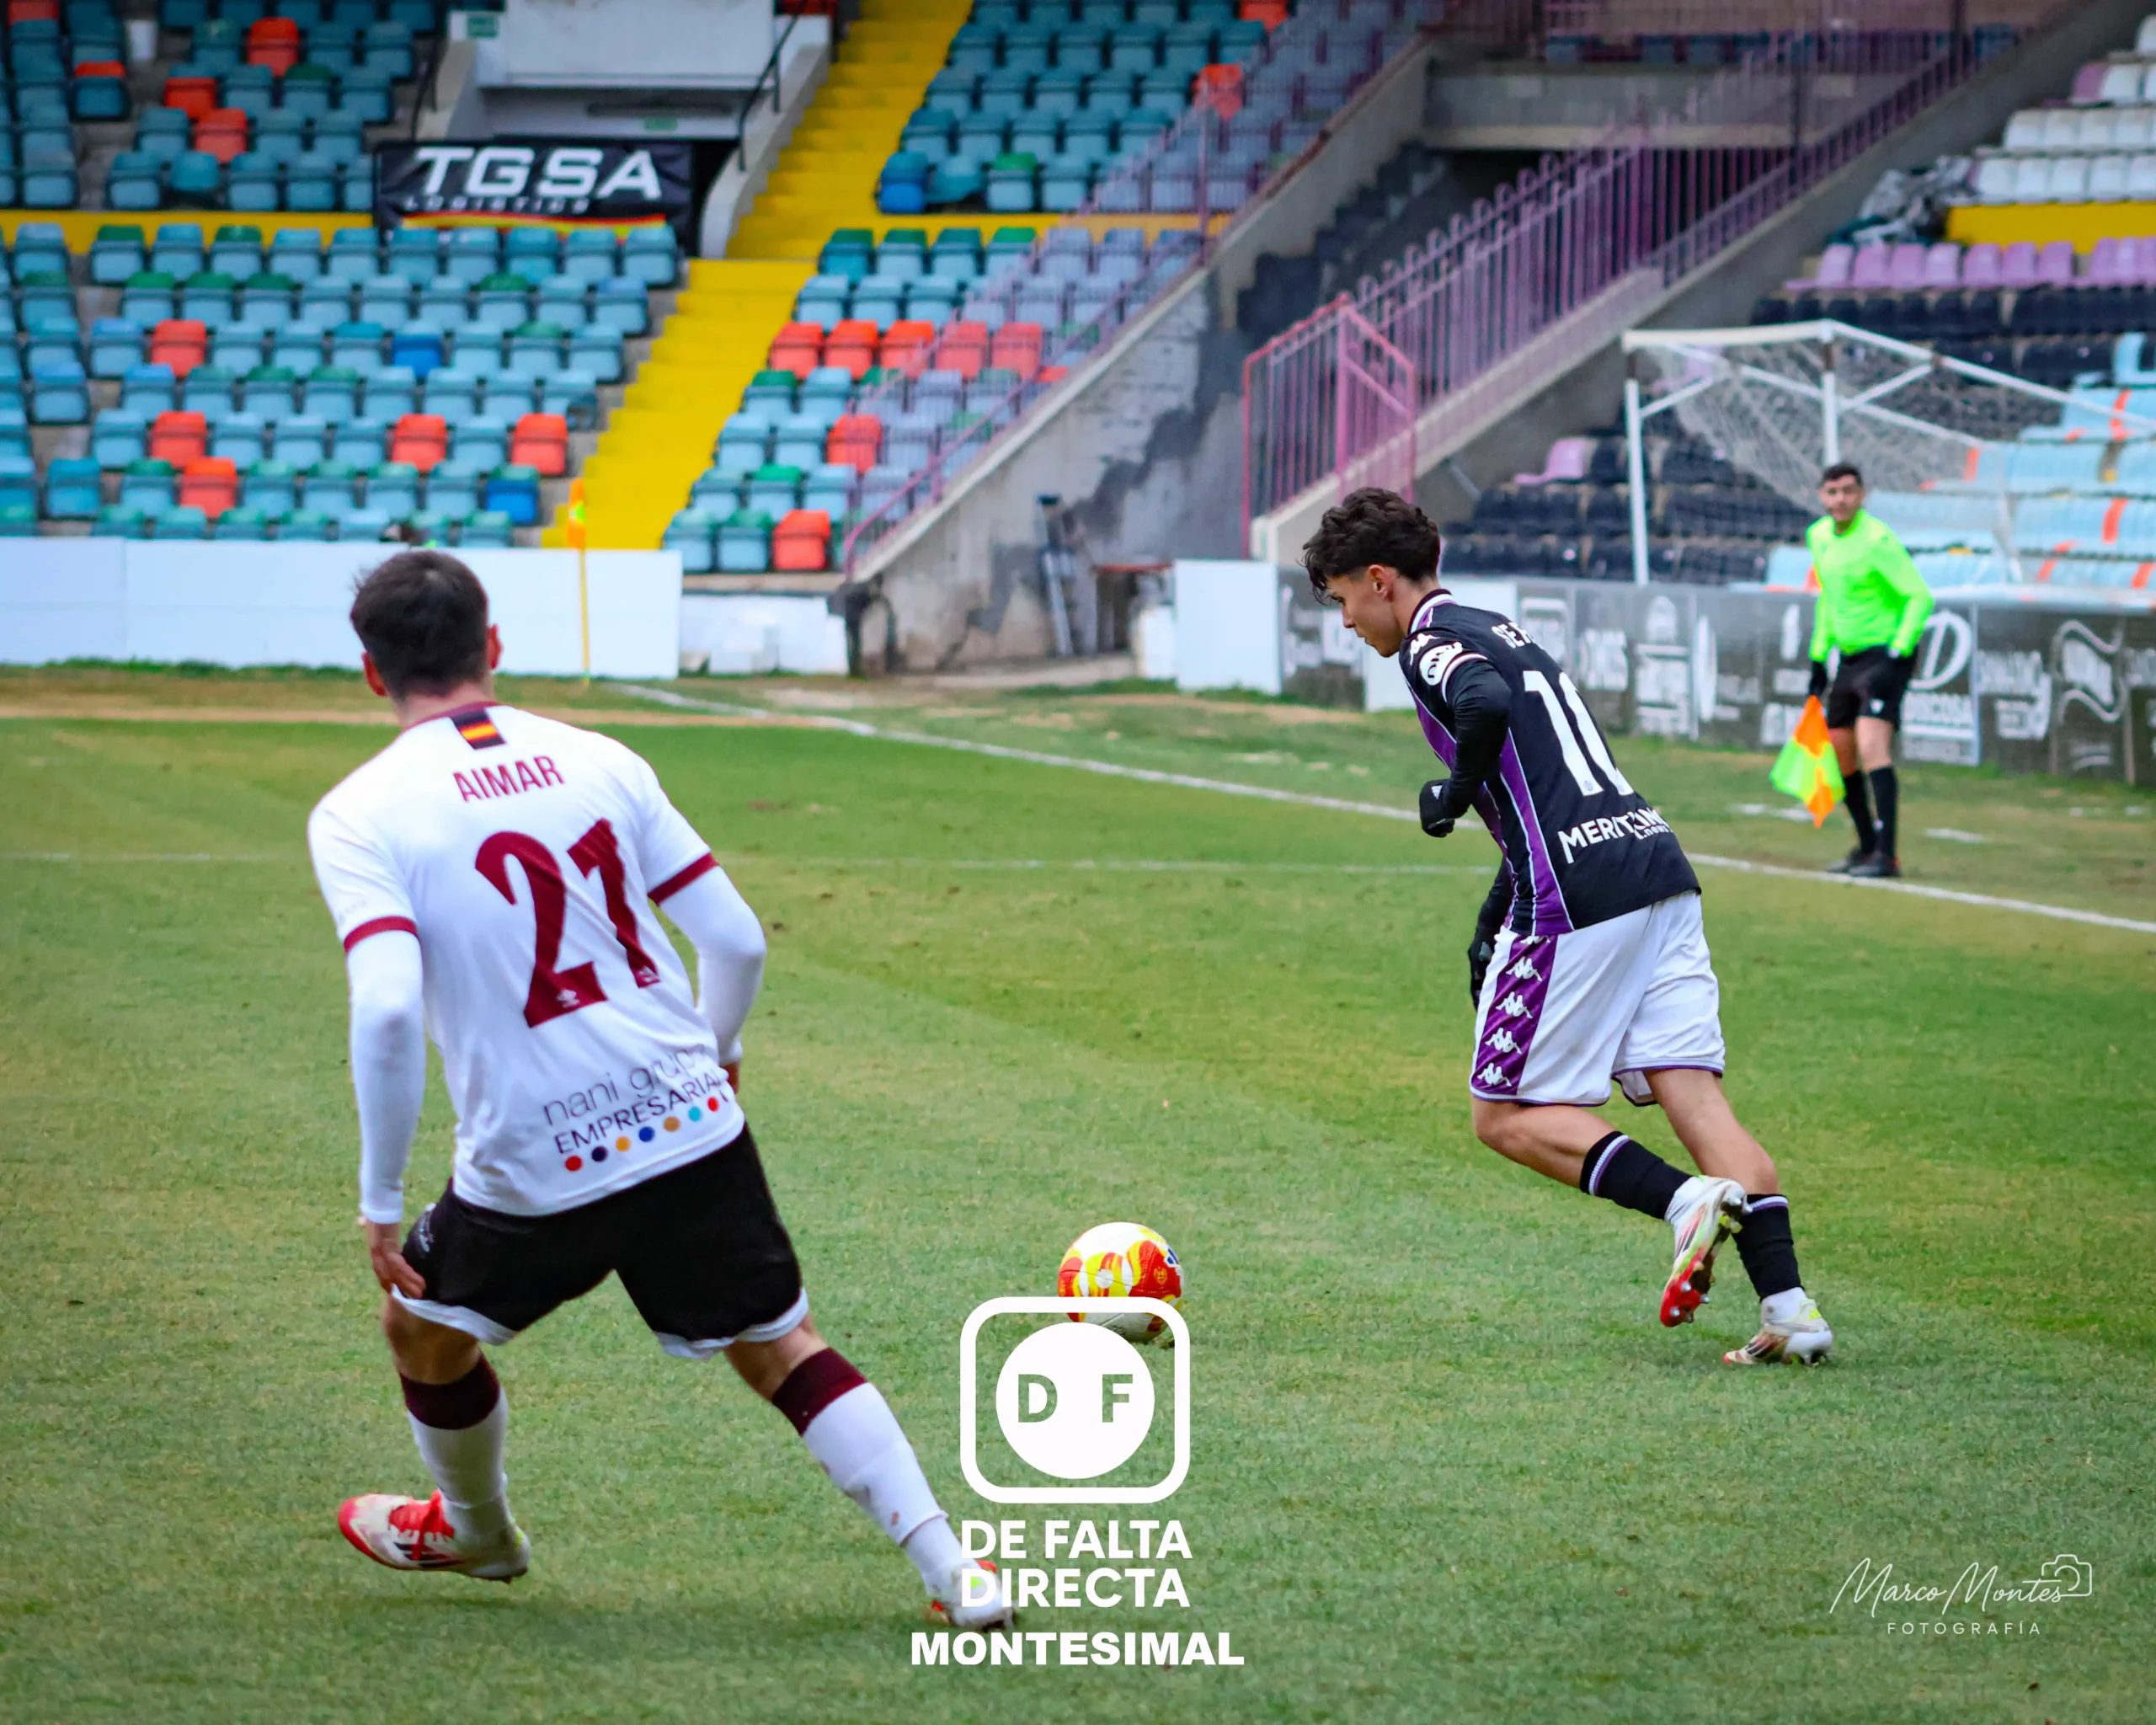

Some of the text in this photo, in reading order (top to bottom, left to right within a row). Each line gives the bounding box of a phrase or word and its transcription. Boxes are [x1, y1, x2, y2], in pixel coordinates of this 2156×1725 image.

[415, 147, 663, 200] TGSA
[452, 755, 565, 803] AIMAR
[475, 817, 661, 1028] 21
[543, 1071, 620, 1126] nani
